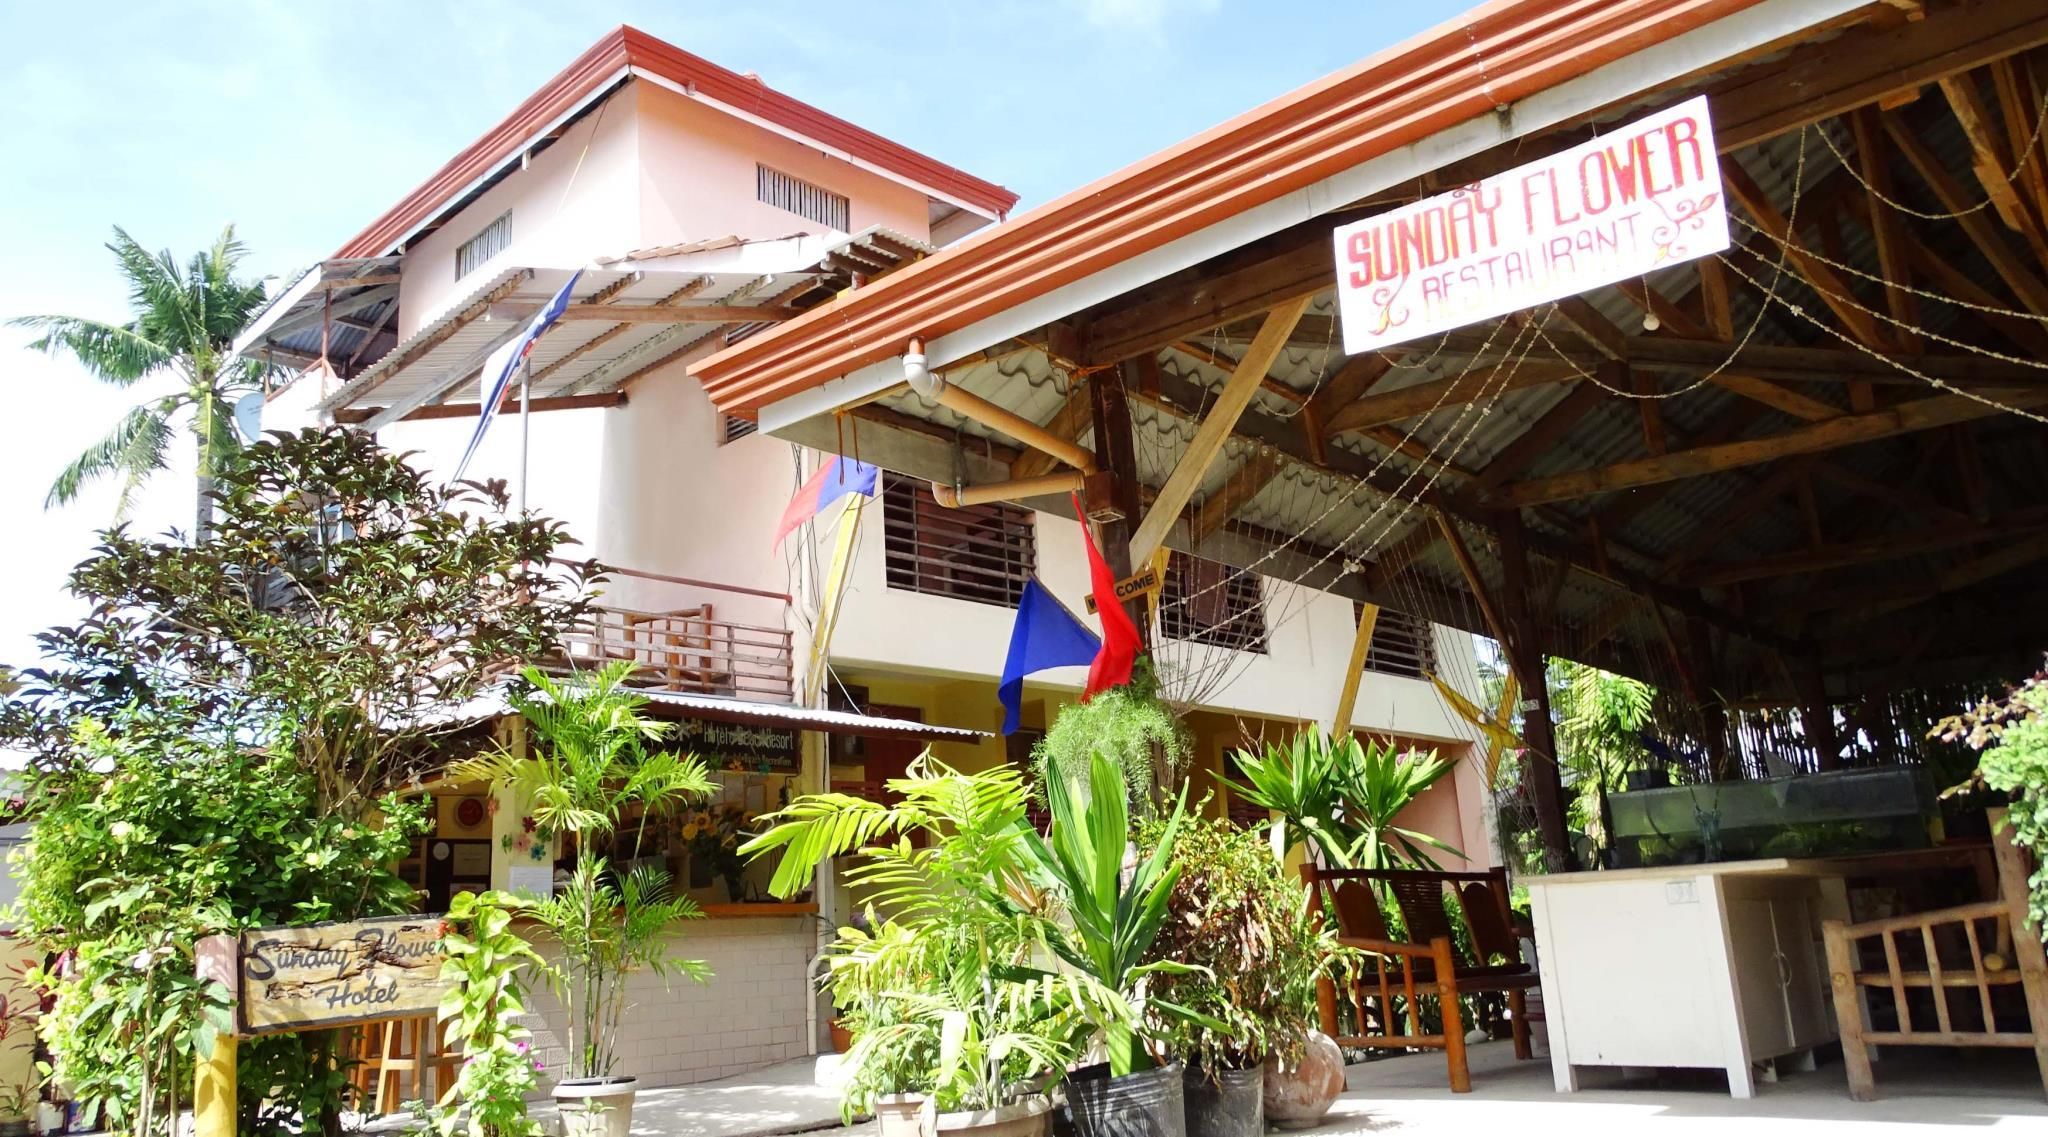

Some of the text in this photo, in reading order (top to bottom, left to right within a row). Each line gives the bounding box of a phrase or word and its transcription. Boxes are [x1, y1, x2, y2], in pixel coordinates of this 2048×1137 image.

[1347, 116, 1704, 288] SUNDAY FLOWER
[1421, 211, 1642, 318] RESTAURANT
[1088, 573, 1155, 609] WCOME
[246, 937, 350, 980] Sunday
[314, 976, 401, 1009] Hotel
